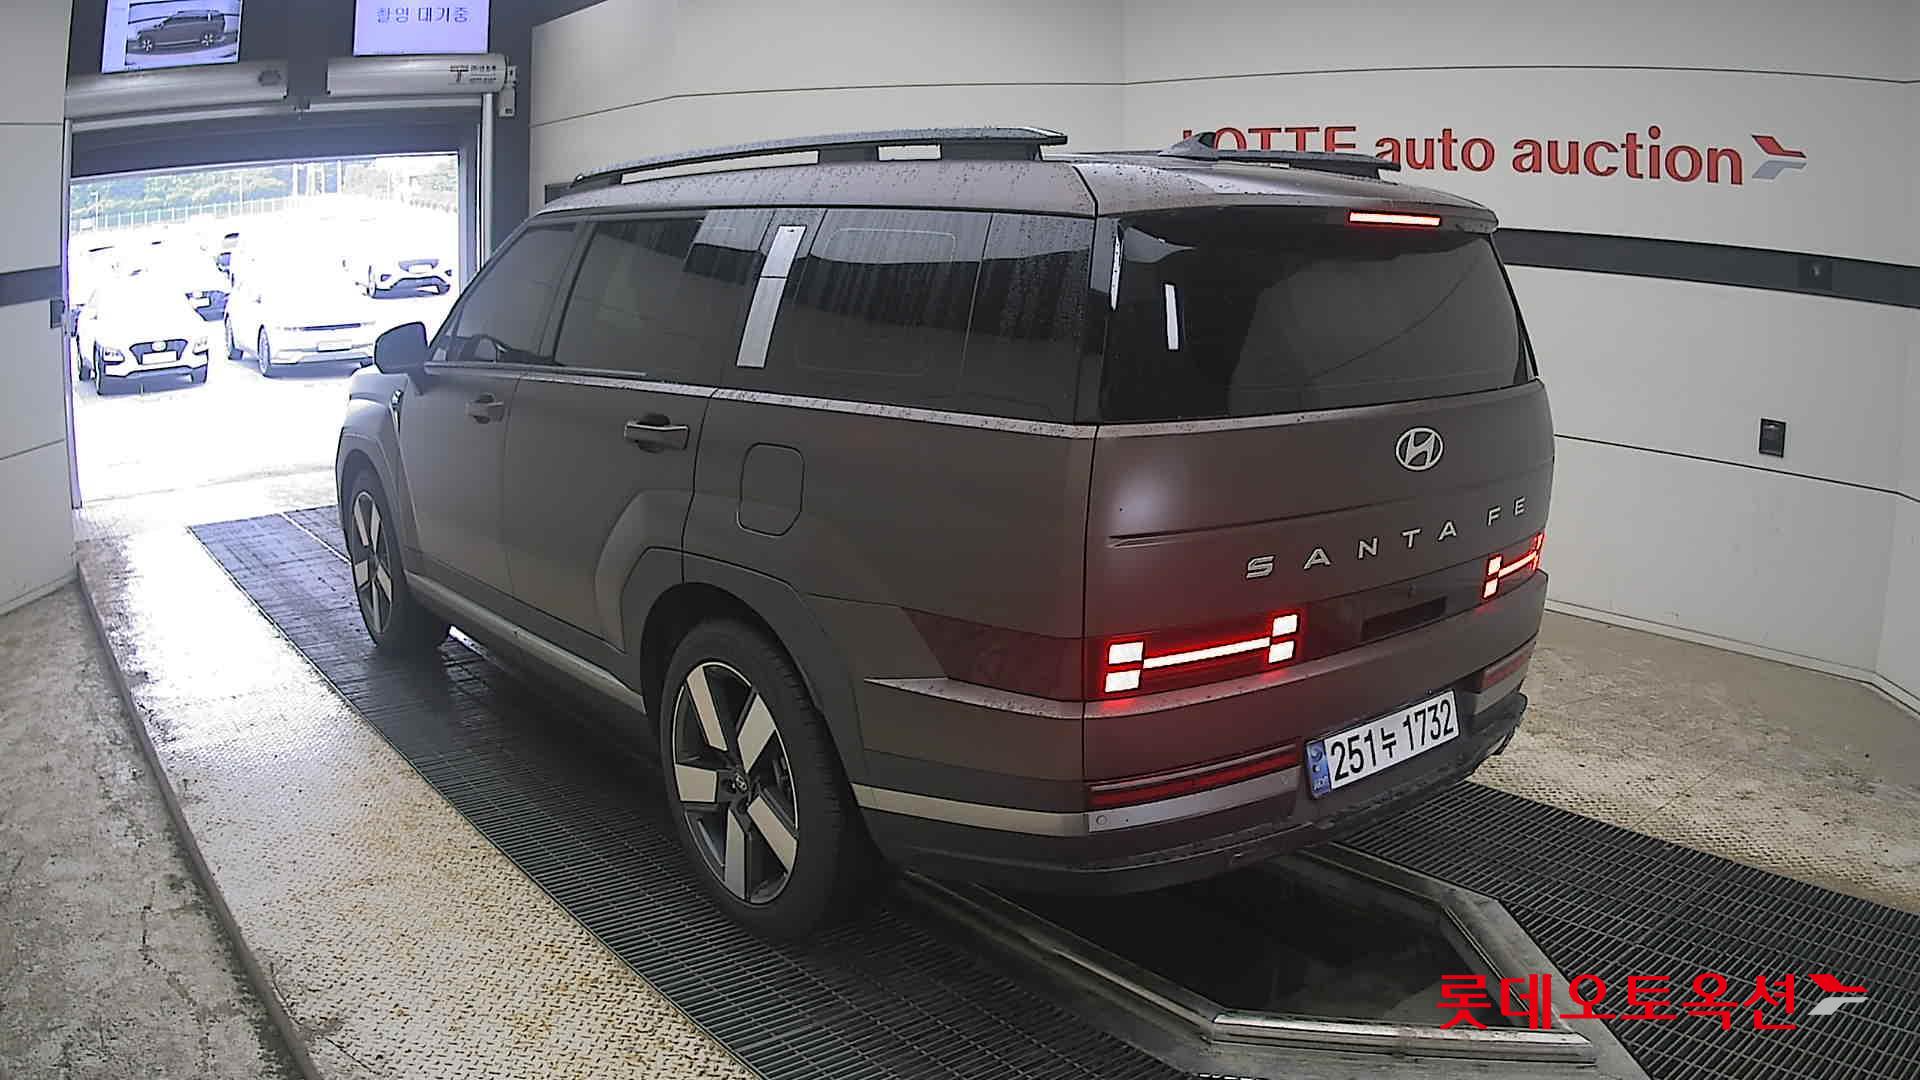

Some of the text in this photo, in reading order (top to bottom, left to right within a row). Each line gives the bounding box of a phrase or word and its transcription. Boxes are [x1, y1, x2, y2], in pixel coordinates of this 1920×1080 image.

[417, 7, 469, 23] 대기중
[1183, 125, 1744, 186] OTTE auto auction
[1245, 496, 1527, 580] SANTA FE
[1330, 698, 1455, 782] 251누 1732
